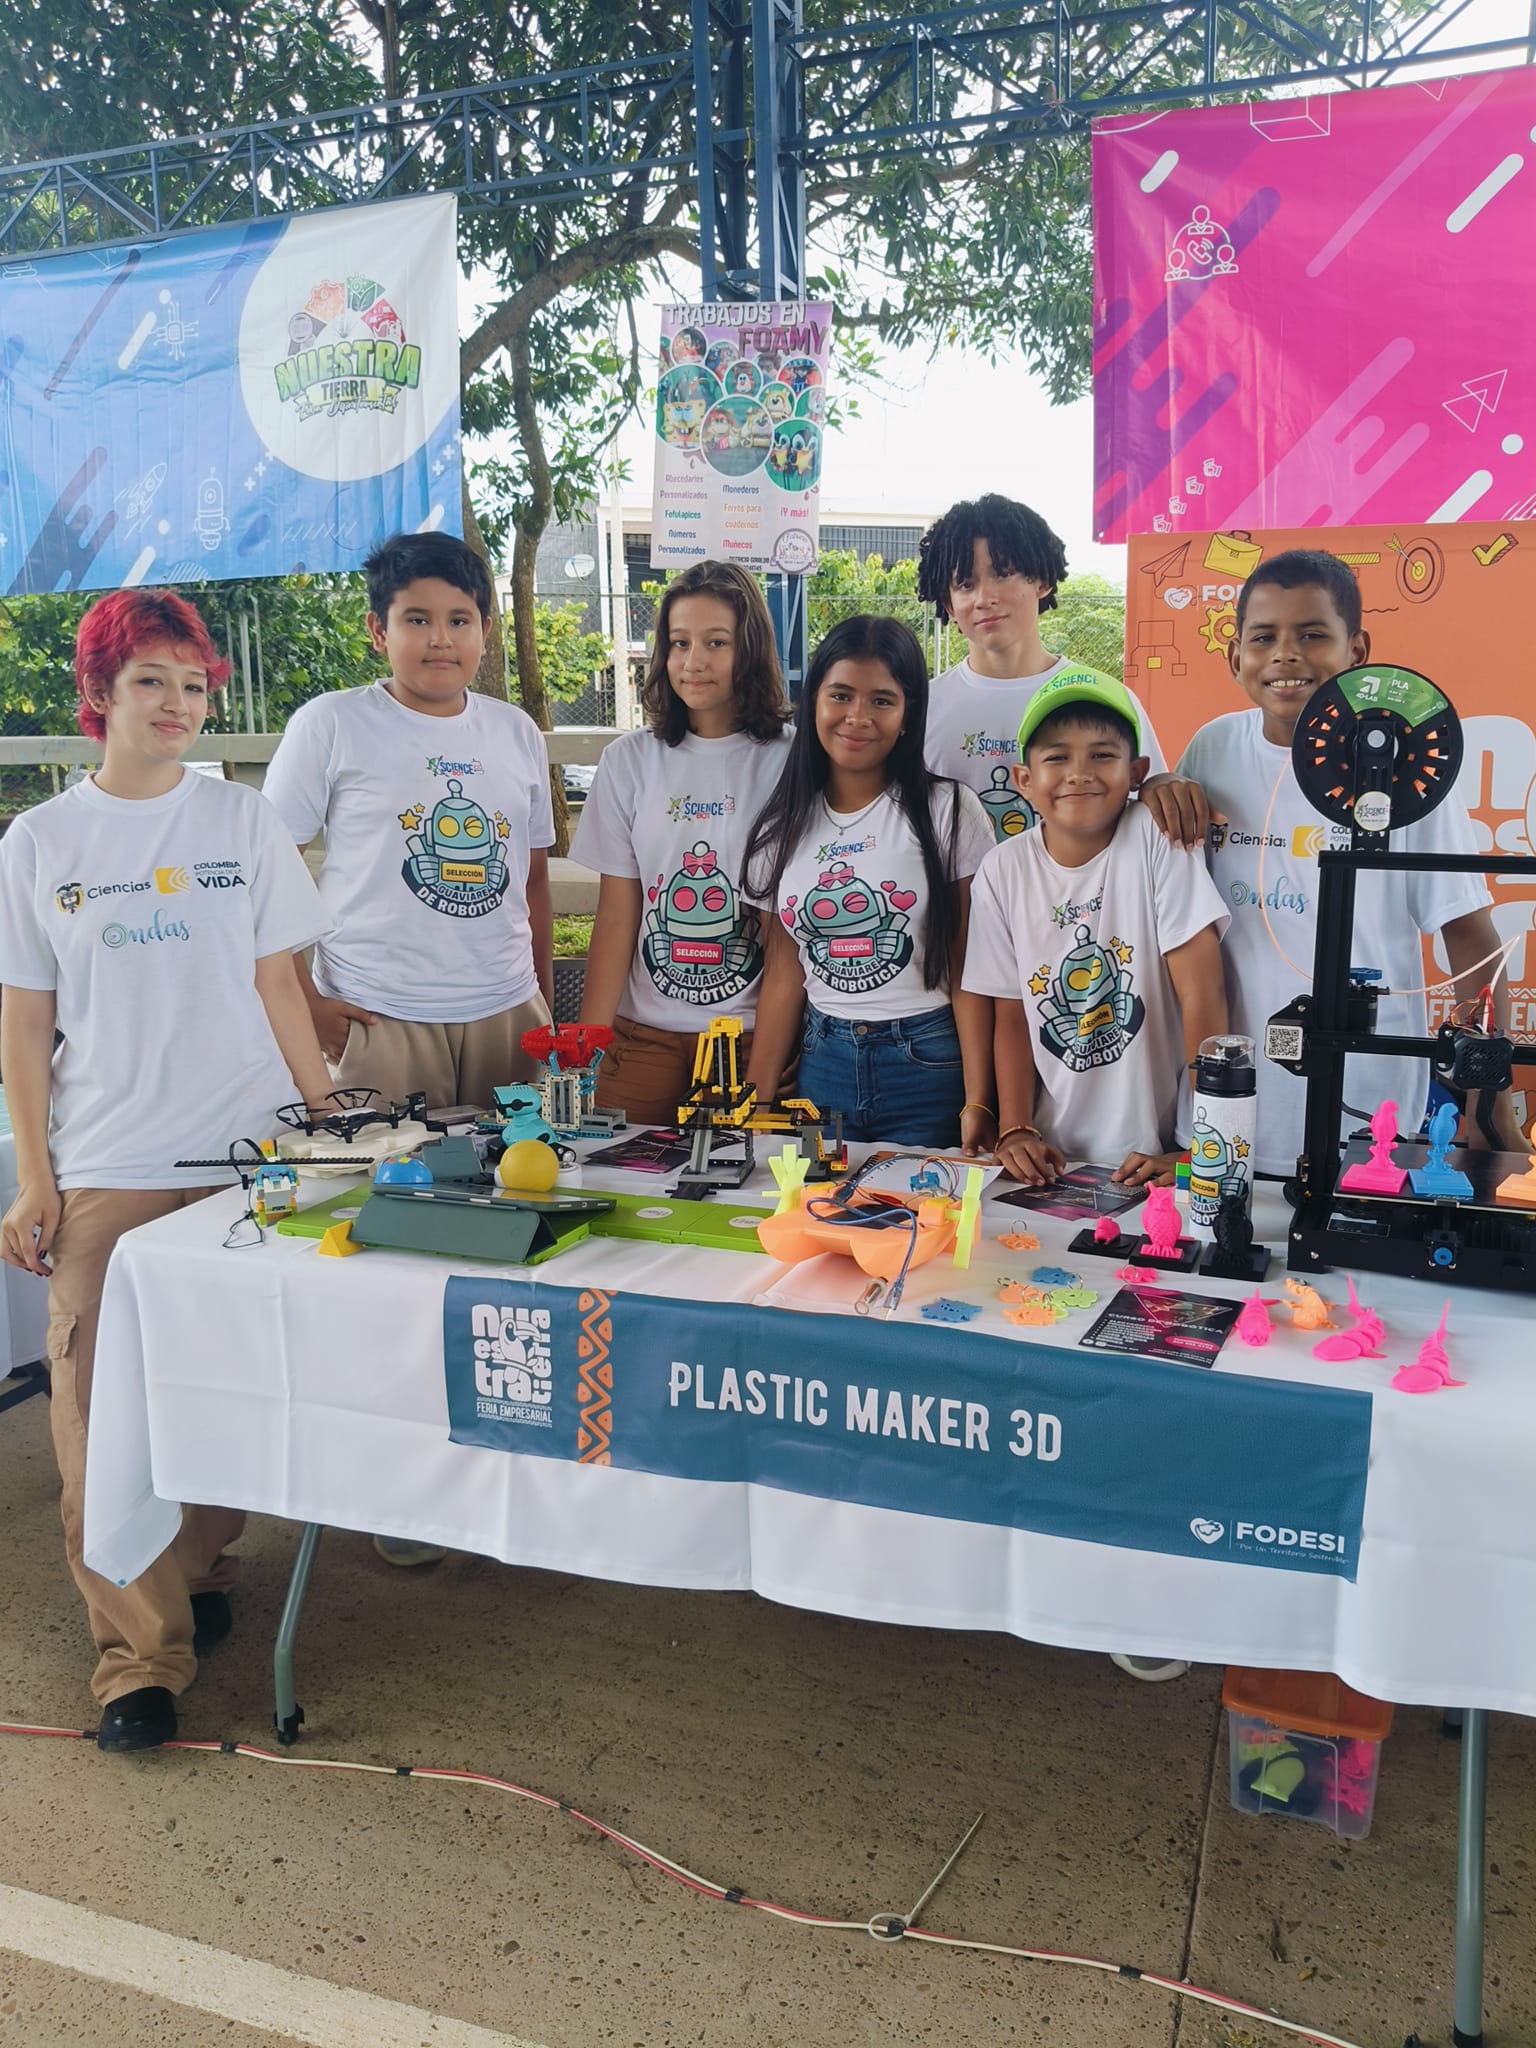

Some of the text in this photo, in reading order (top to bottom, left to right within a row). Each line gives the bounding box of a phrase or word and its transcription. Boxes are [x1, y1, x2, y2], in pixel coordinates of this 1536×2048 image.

[667, 303, 807, 328] TRABAJOS EN
[738, 321, 828, 357] FOAMY
[274, 339, 421, 402] NUESTRA
[321, 379, 368, 400] TIERRA
[660, 490, 708, 500] Personalizados
[722, 484, 759, 495] Monederos
[747, 504, 761, 514] para
[790, 507, 809, 518] más!
[725, 519, 759, 529] cuadernos
[668, 529, 696, 539] Números
[658, 545, 706, 556] Personalizados
[723, 539, 753, 550] Muñecos
[1052, 673, 1100, 690] SCIENCE
[1391, 679, 1409, 690] PLA
[978, 737, 1017, 754] SCIENCE
[440, 761, 475, 775] SCIENCE
[684, 802, 724, 816] SCIENCE
[829, 841, 865, 857] SCIENCE
[194, 861, 240, 870] COLOMBIA
[446, 868, 483, 878] SELECCIÓN
[197, 875, 246, 889] VIDA
[87, 880, 151, 900] Ciencias
[437, 886, 489, 901] GUAVIARE
[417, 886, 503, 917] DE ROBÓTICA
[1068, 896, 1102, 920] SCIENCE
[102, 908, 192, 949] Ondas
[676, 947, 719, 959] SELECCIÓN
[833, 944, 870, 952] SELECCIÓN
[828, 961, 879, 977] GUAVIARE
[669, 969, 725, 986] GUAVIARE
[814, 963, 901, 992] DE ROBÓTICA
[653, 968, 748, 1004] DE ROBÓTICA
[1062, 1049, 1075, 1067] DE
[1108, 1312, 1145, 1323] CURSO
[477, 1403, 552, 1423] FERIA EMPRESARIAL
[669, 1361, 1062, 1462] PLASTIC MAKER 3D
[1236, 1522, 1345, 1554] FODESI
[1270, 1547, 1306, 1558] Territorio
